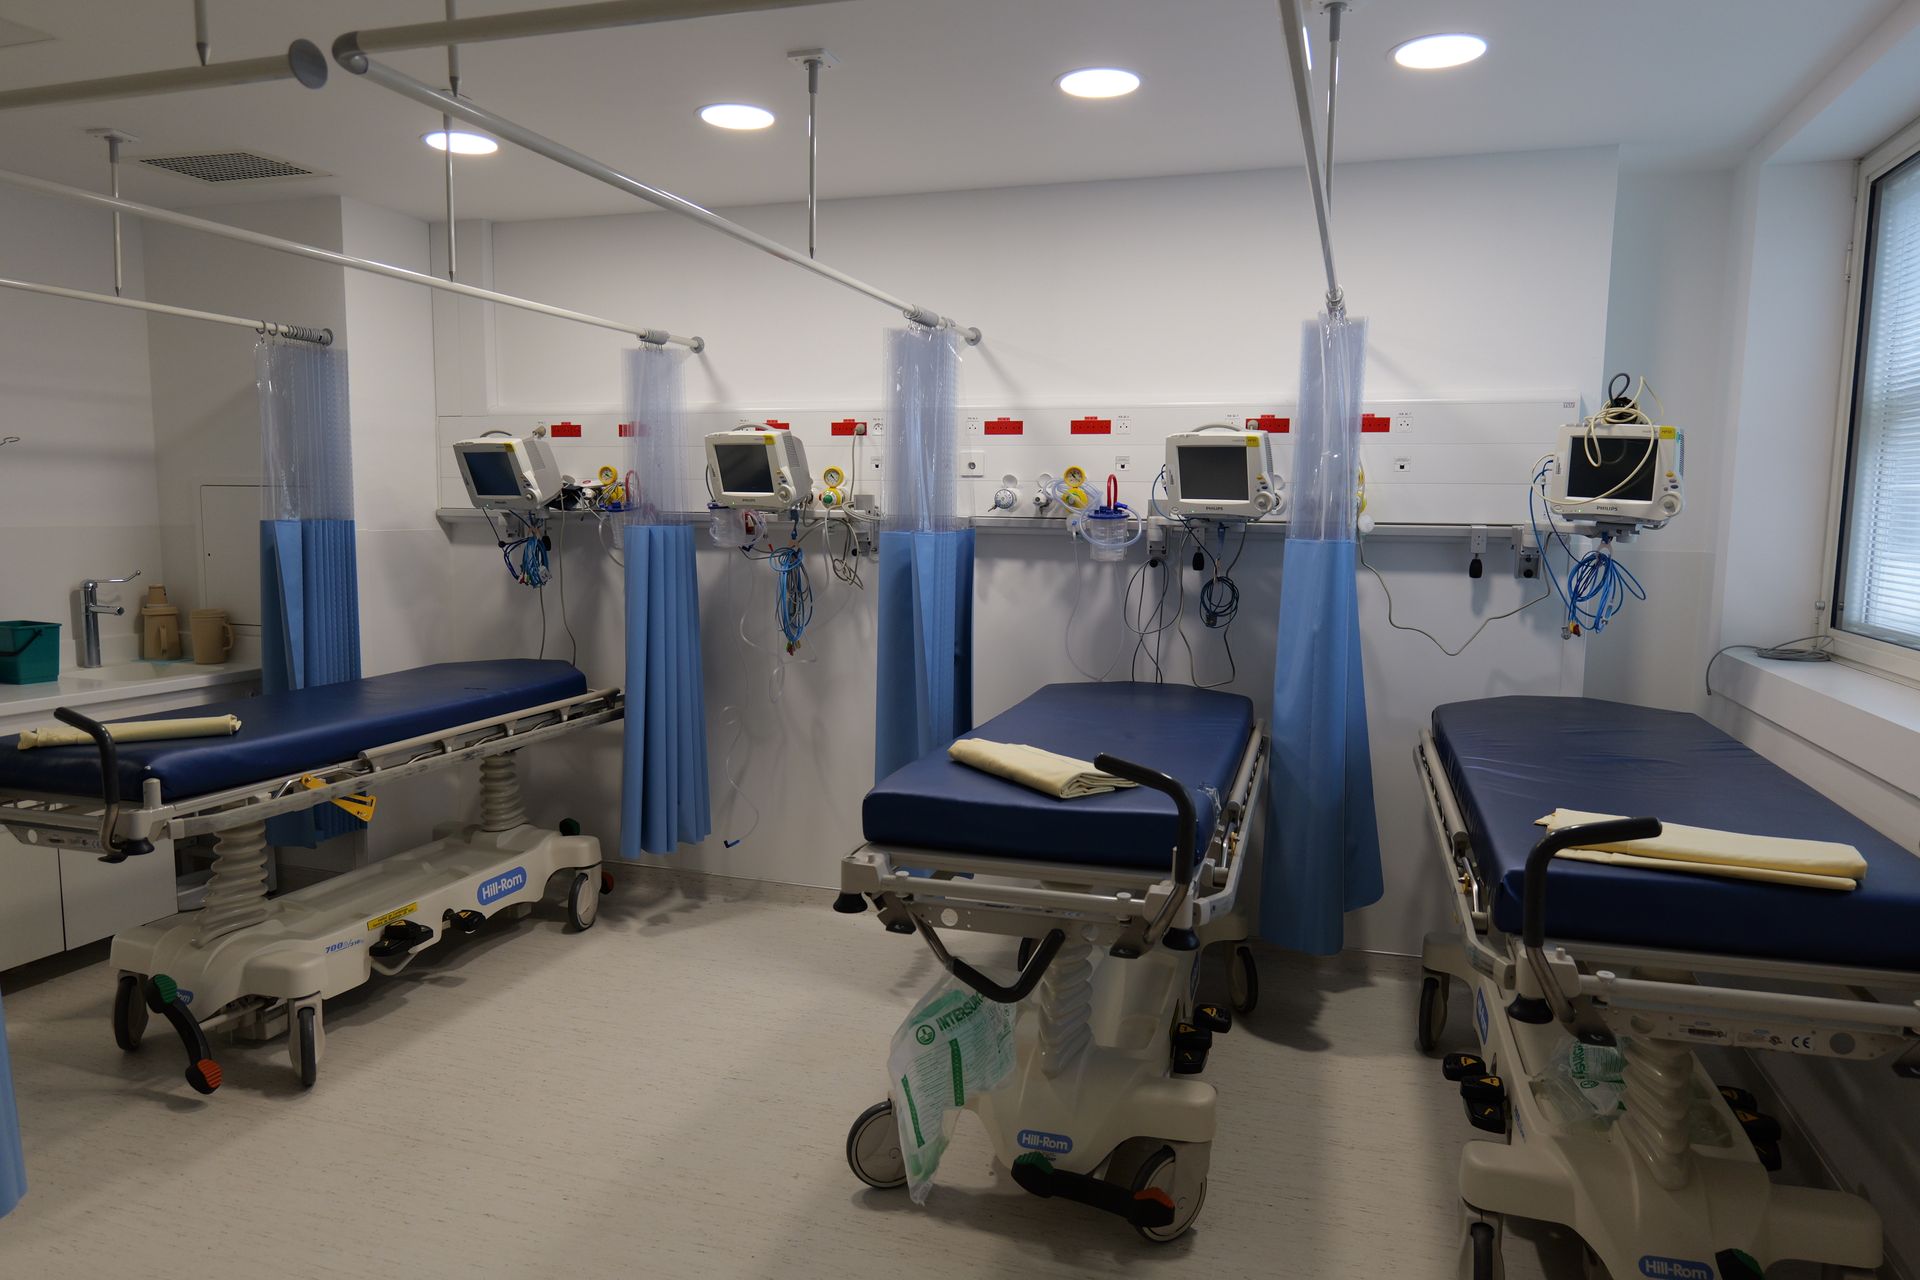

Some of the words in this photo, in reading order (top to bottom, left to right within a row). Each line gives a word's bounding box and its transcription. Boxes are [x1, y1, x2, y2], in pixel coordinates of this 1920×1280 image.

[1596, 504, 1618, 512] PHILIPS
[482, 873, 523, 900] Hill-Rom
[1021, 1132, 1069, 1150] Hill-Rom
[1645, 1259, 1708, 1280] Hill-Rom
